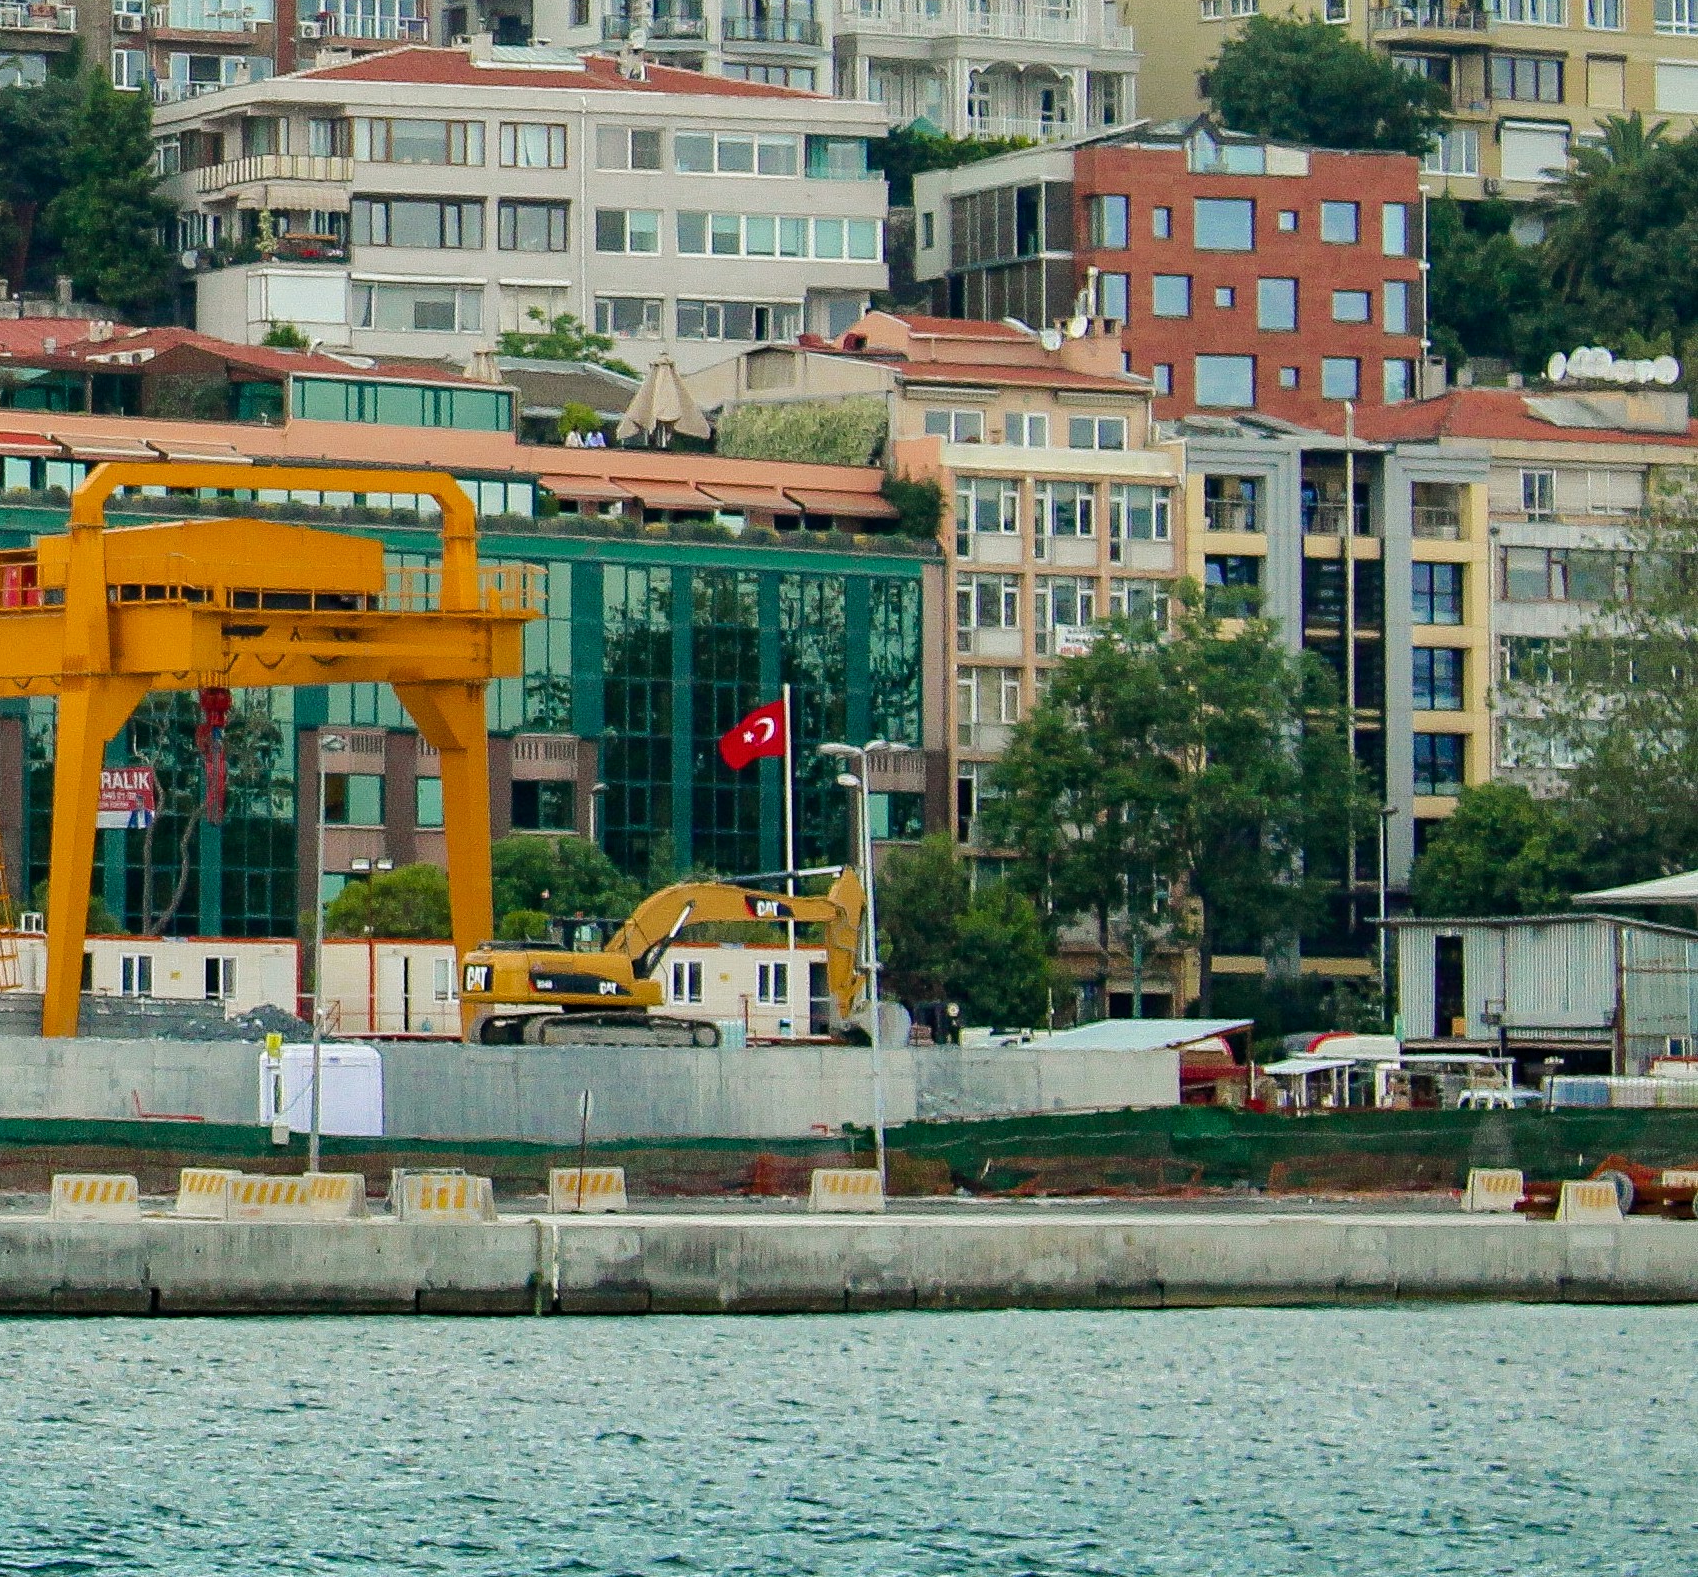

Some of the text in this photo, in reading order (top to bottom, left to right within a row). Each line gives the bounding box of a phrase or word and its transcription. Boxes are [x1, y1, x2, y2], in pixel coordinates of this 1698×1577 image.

[100, 771, 151, 790] RALIK
[757, 899, 779, 917] CAT
[466, 965, 488, 992] CAT
[598, 980, 617, 996] CAT
